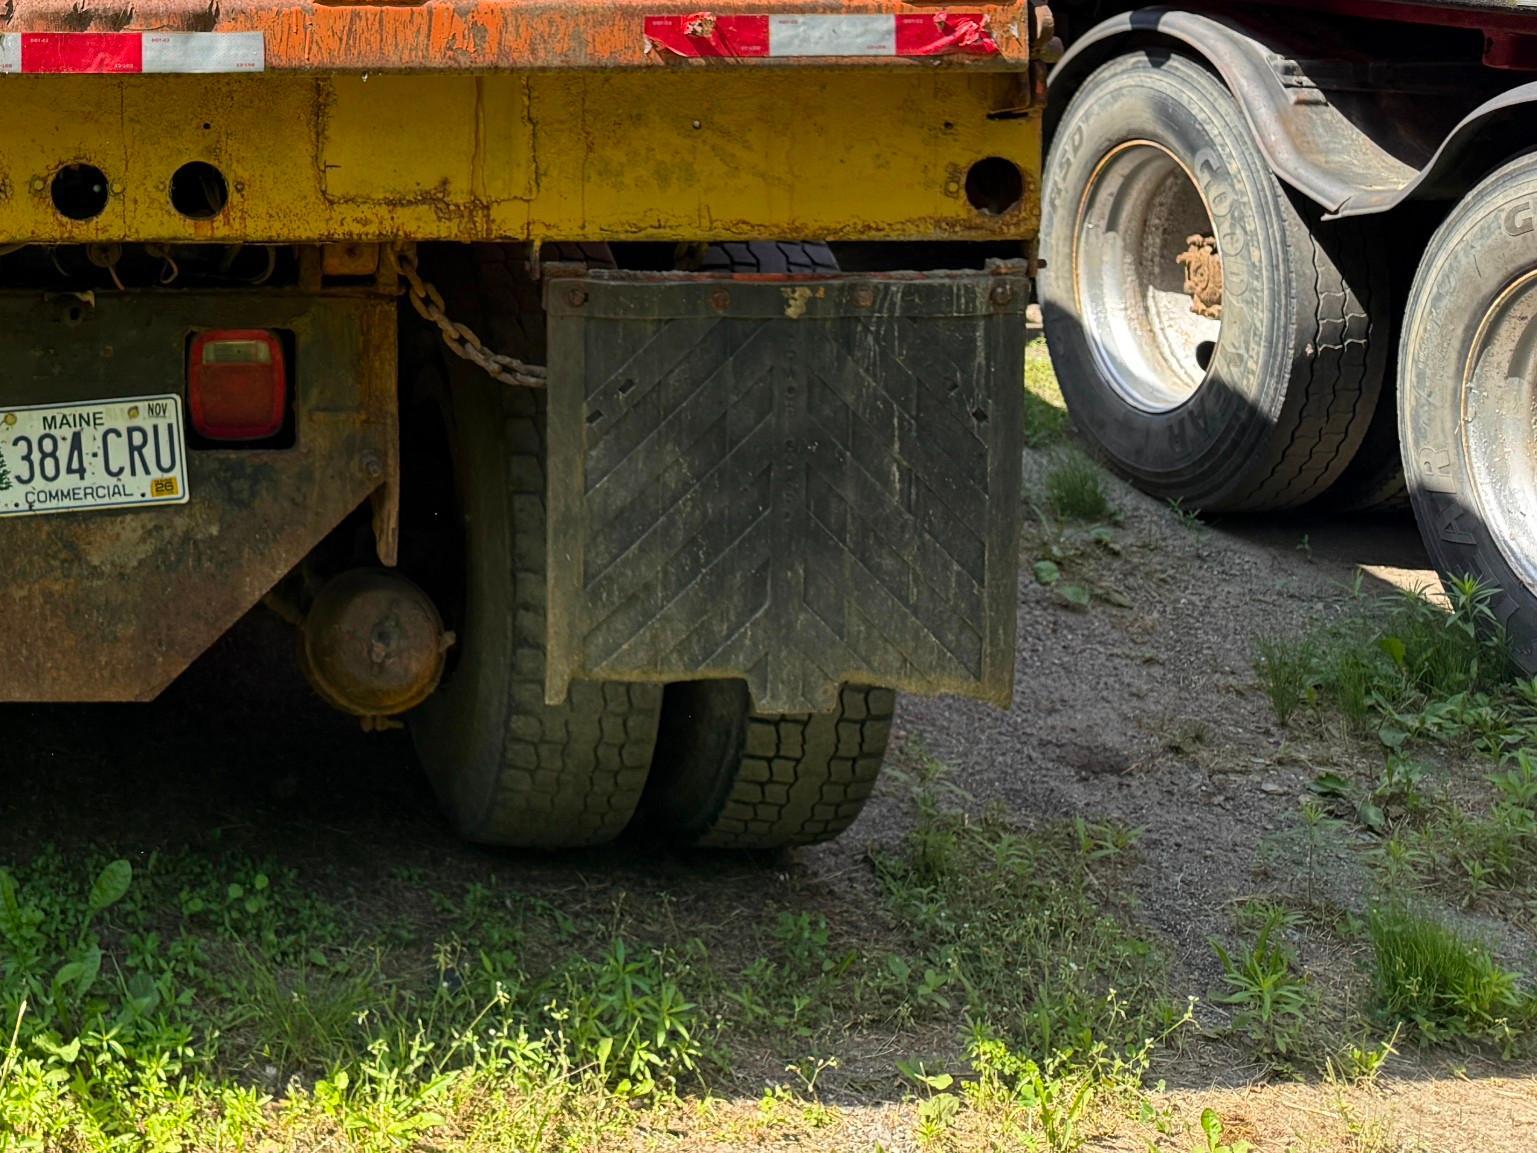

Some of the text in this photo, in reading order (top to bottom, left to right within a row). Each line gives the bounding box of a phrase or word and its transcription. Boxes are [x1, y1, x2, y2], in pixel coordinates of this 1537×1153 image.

[148, 402, 168, 417] NOV
[43, 411, 105, 431] MAINE
[25, 483, 134, 505] COMMERCIAL
[155, 481, 174, 493] 26
